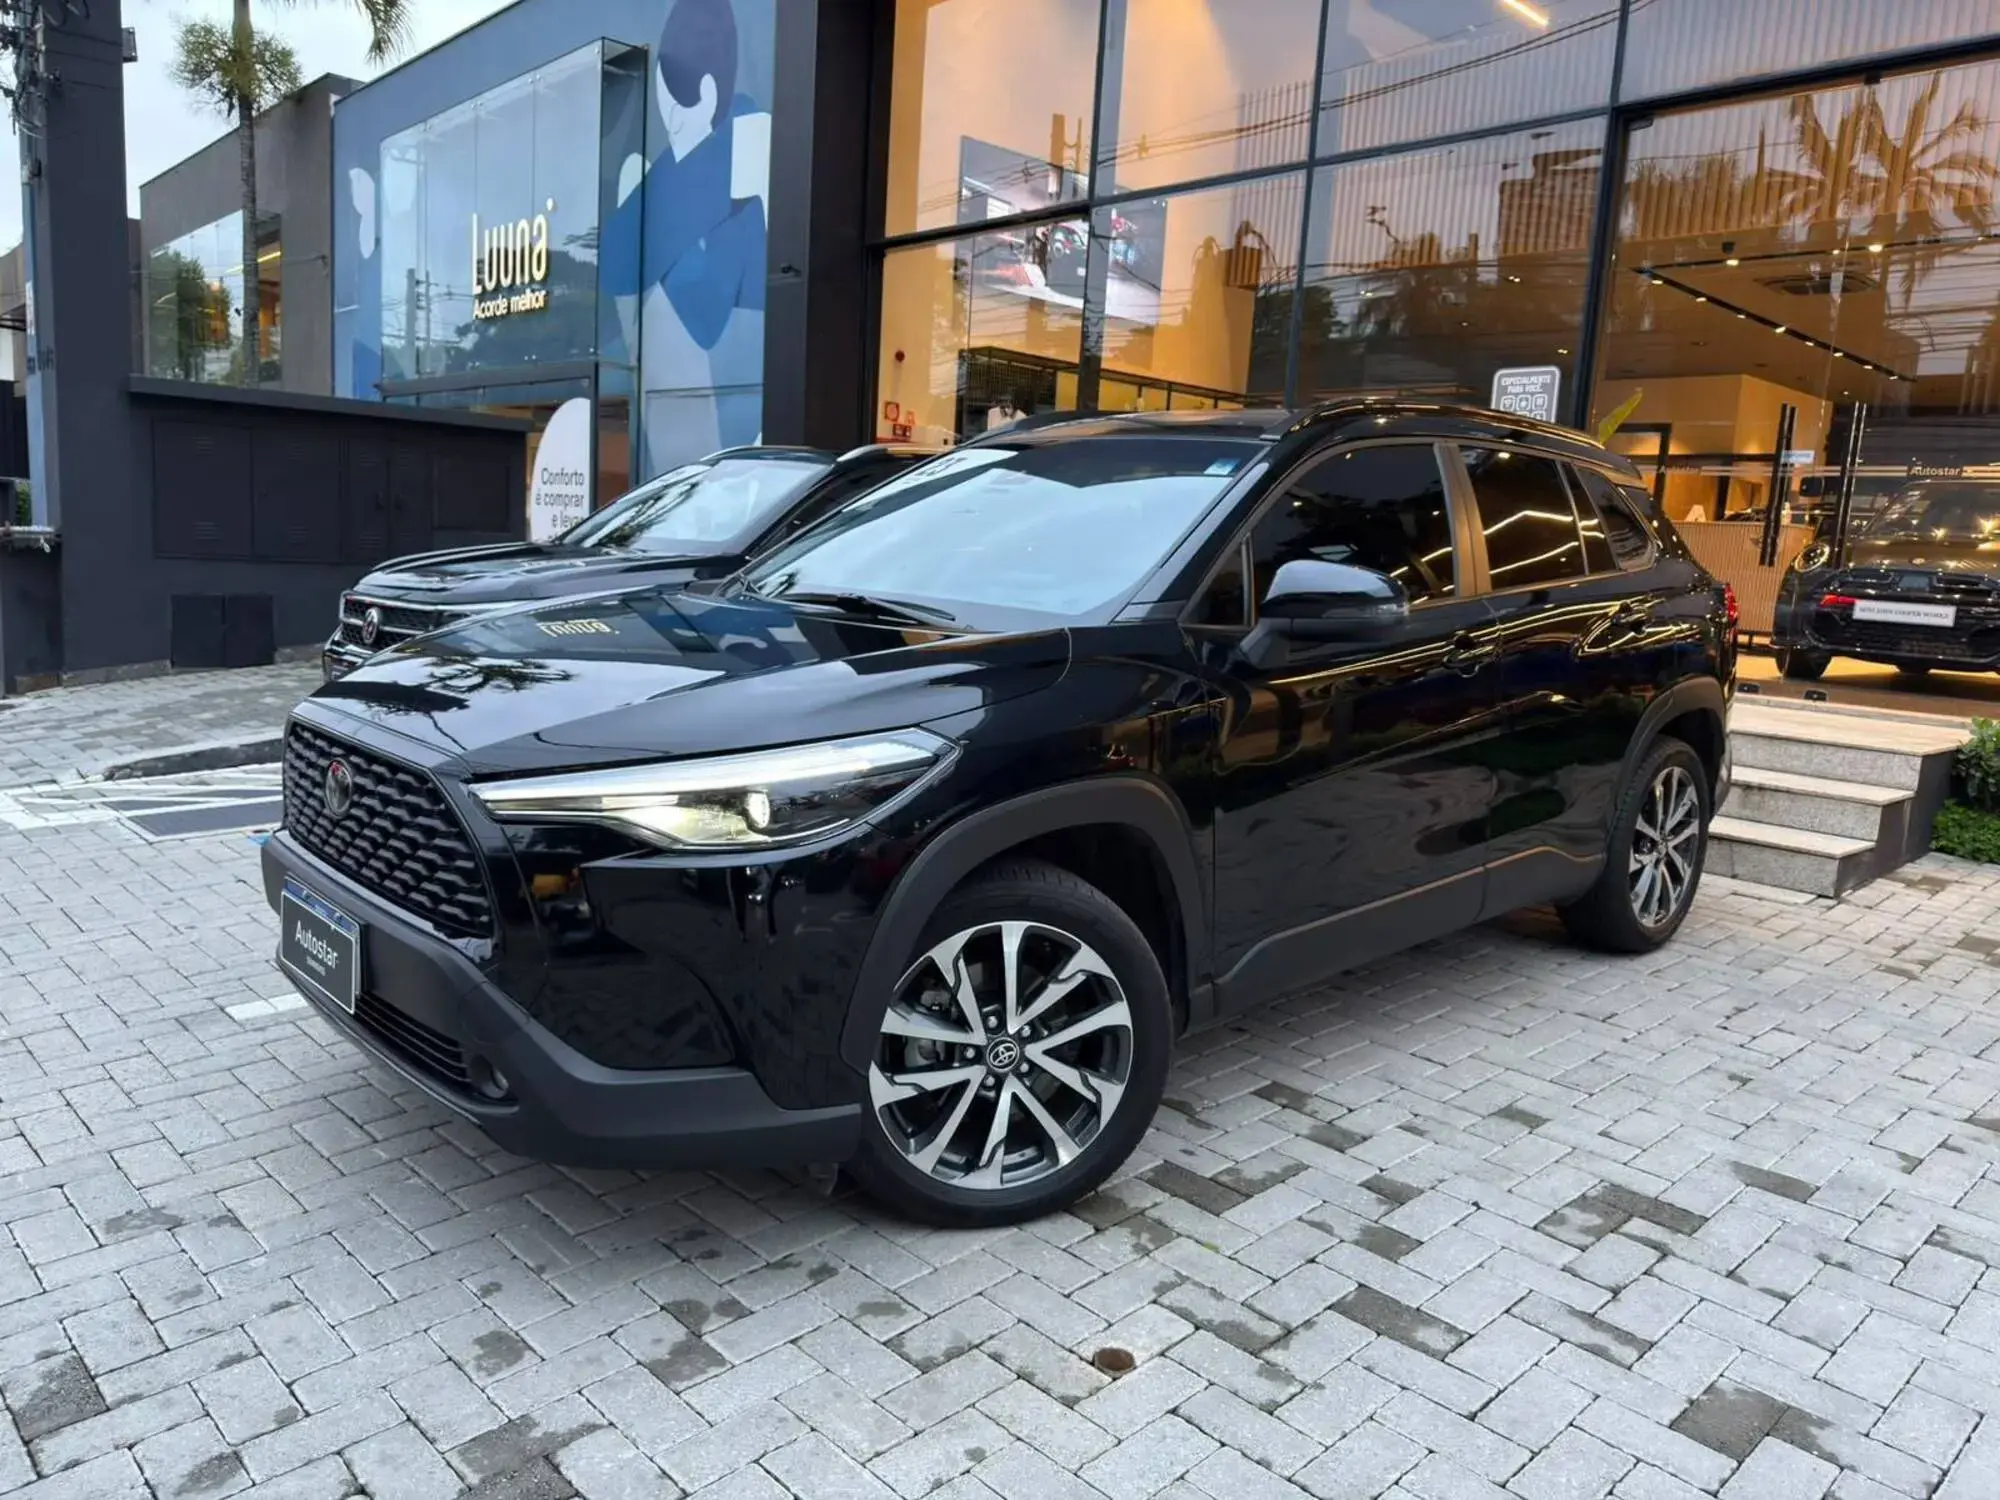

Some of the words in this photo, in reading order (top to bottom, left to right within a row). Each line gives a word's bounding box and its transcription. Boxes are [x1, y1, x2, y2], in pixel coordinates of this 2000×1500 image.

[473, 295, 509, 320] Acorde
[510, 288, 547, 314] melhor
[540, 467, 585, 486] Conforto
[1909, 465, 1961, 476] Autostar
[543, 491, 585, 510] comprar
[551, 514, 558, 529] e
[295, 919, 338, 969] Autostar
